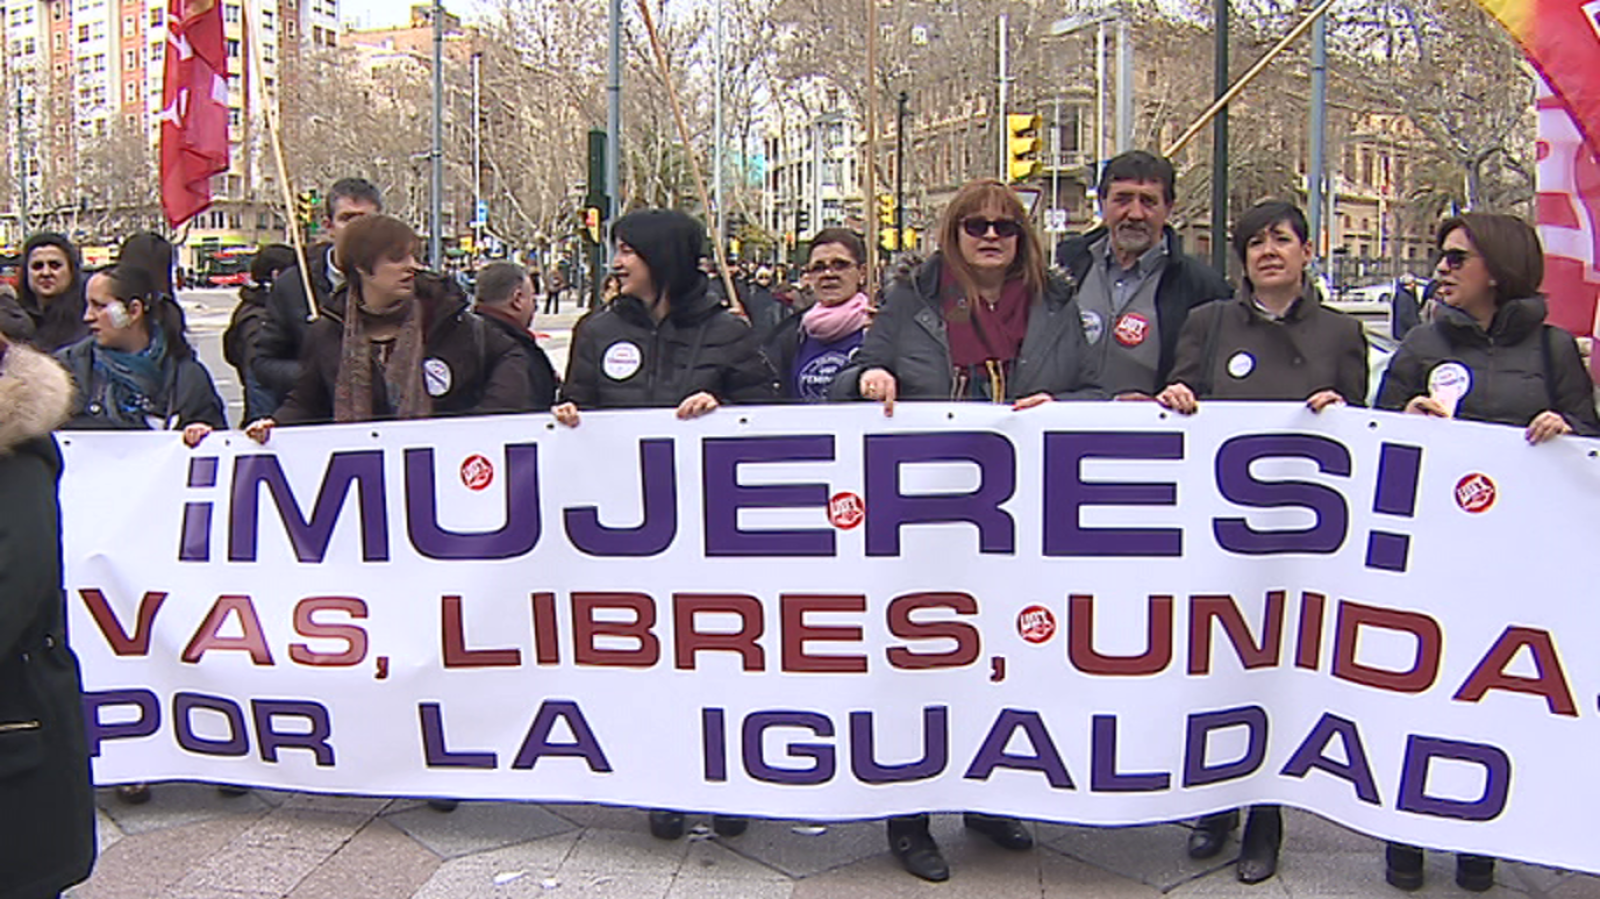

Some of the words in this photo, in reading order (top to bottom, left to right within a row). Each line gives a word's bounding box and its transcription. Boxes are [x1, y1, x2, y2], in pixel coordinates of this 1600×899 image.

[179, 428, 1422, 572] ¡MUJERES!
[442, 592, 1005, 682] LIBRES,
[1068, 590, 1600, 717] UNIDA
[83, 689, 335, 767] POR
[419, 700, 613, 773] LA
[702, 706, 1511, 821] IGUALDAD
